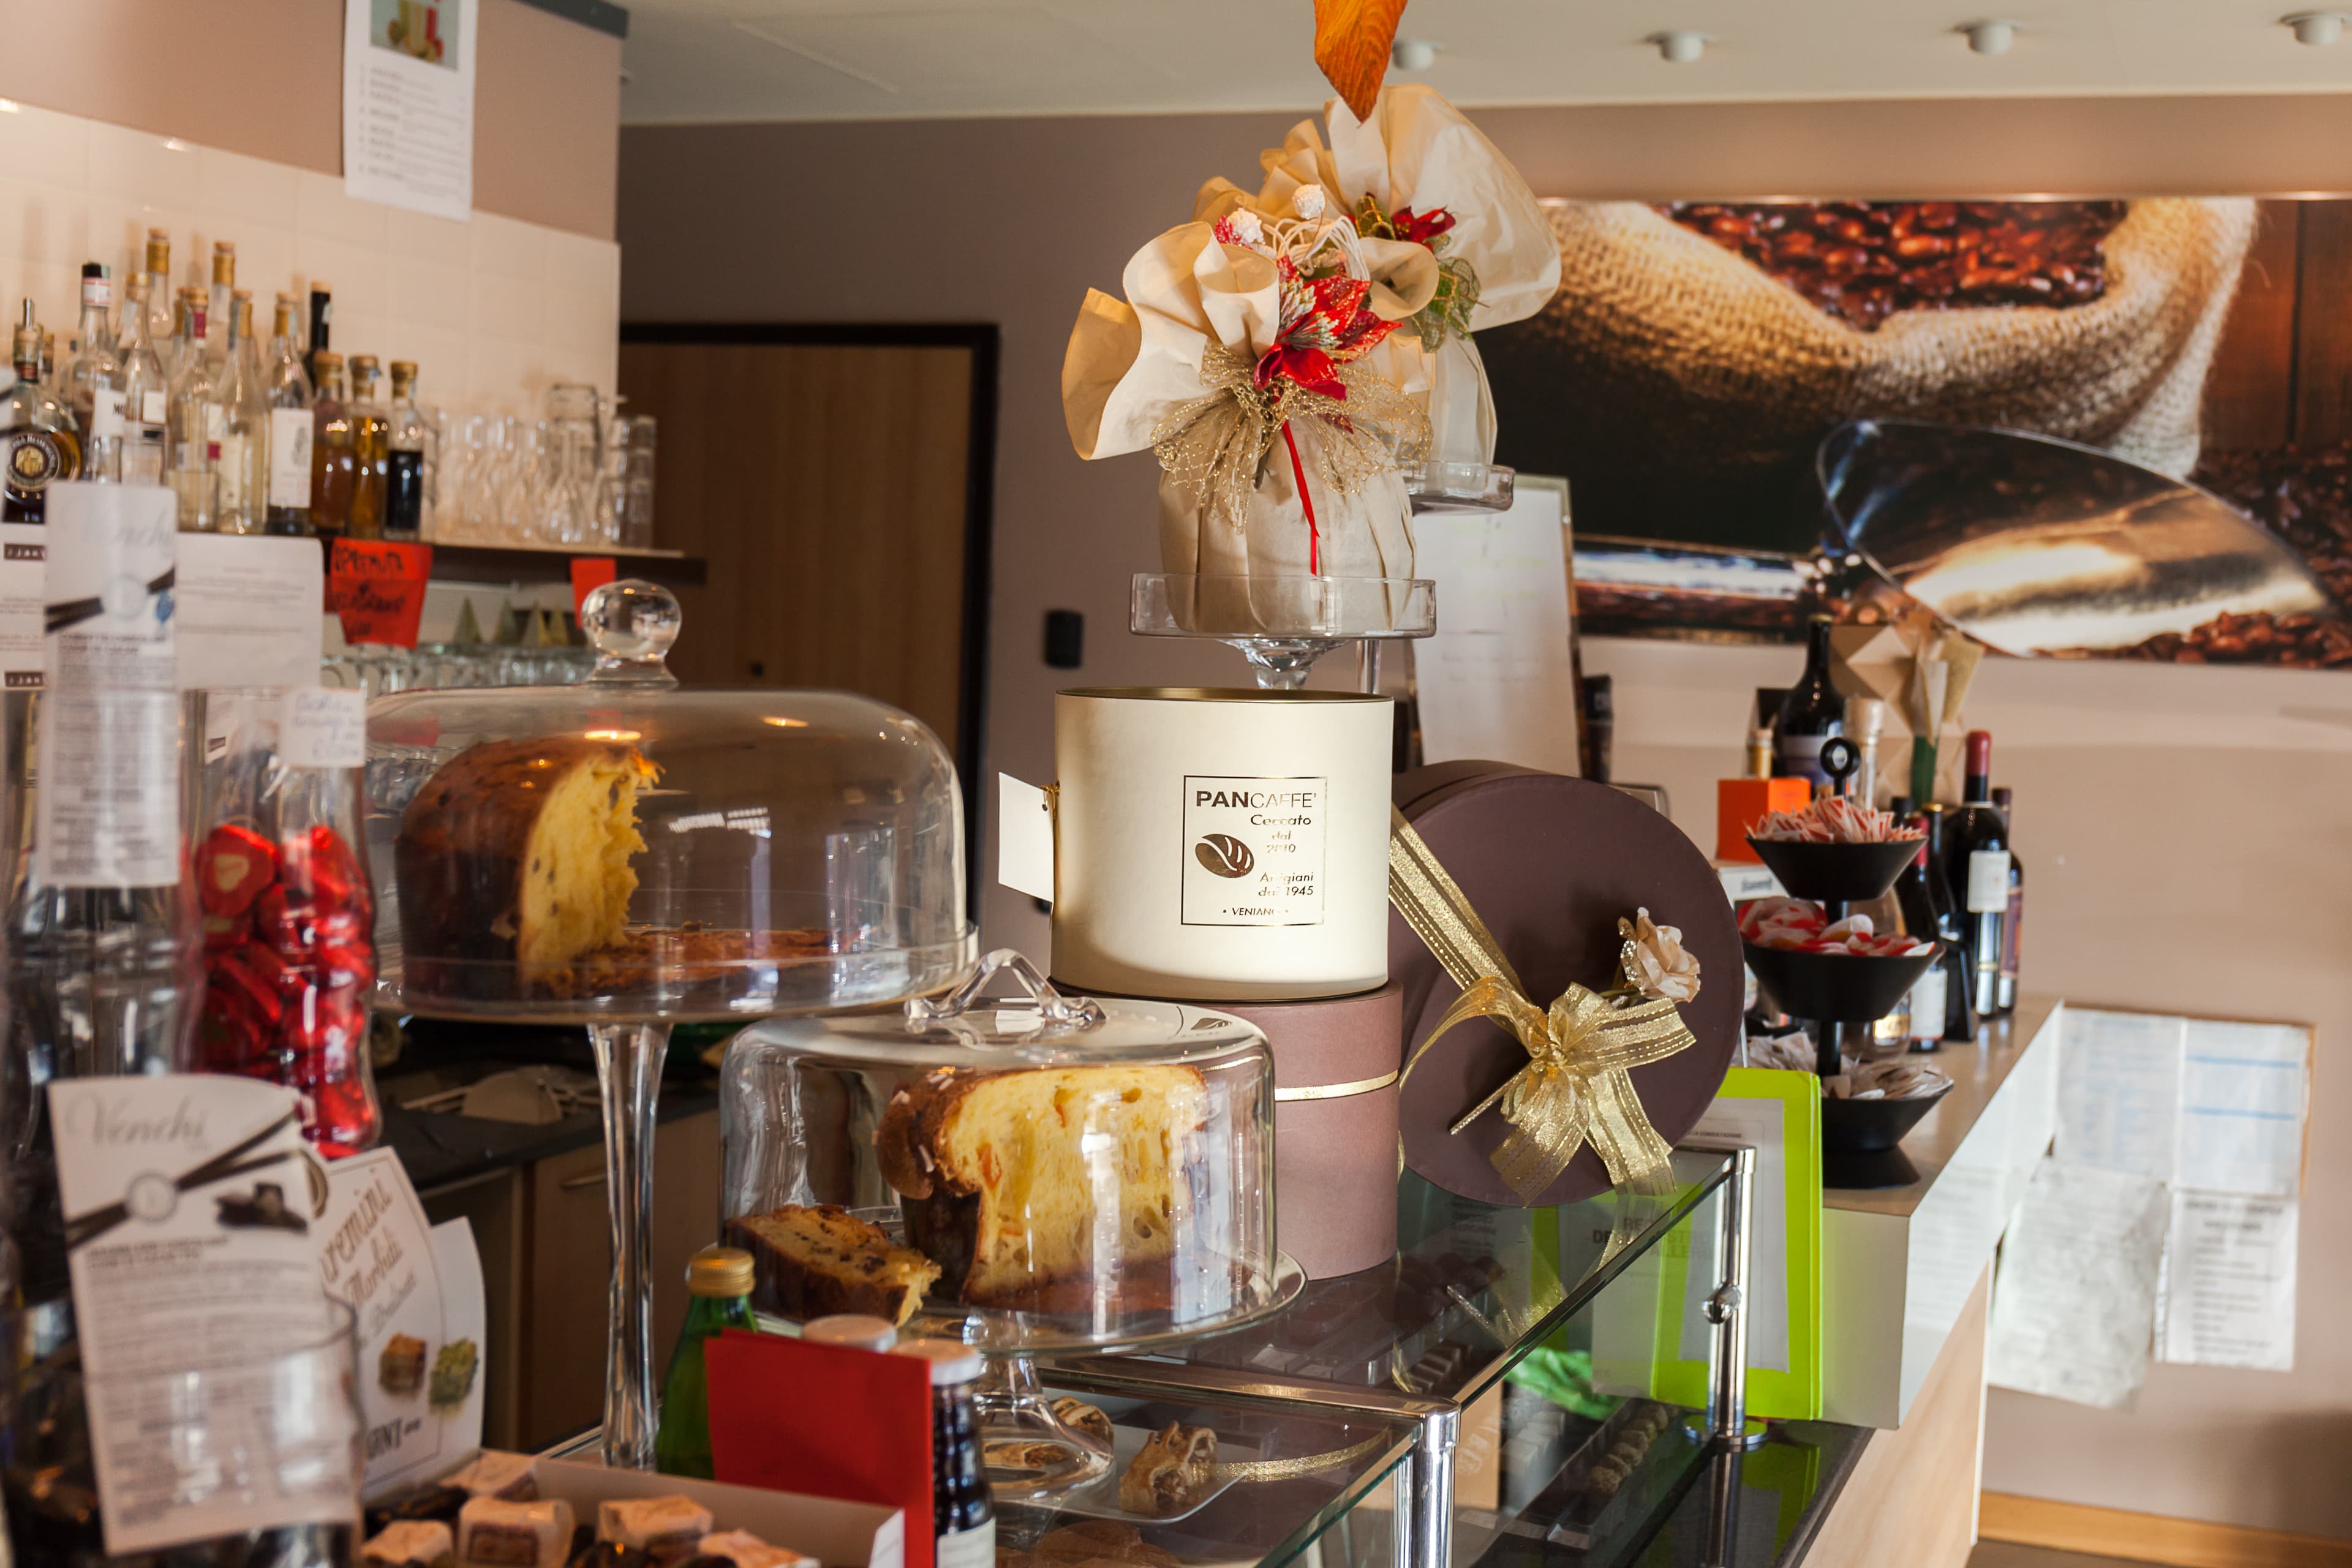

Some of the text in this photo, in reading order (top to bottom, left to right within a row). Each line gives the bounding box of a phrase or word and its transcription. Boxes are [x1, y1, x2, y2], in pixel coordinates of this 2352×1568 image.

[1250, 813, 1311, 826] Ceccato
[1259, 872, 1314, 884] Argiani
[1258, 885, 1314, 897] da 1945
